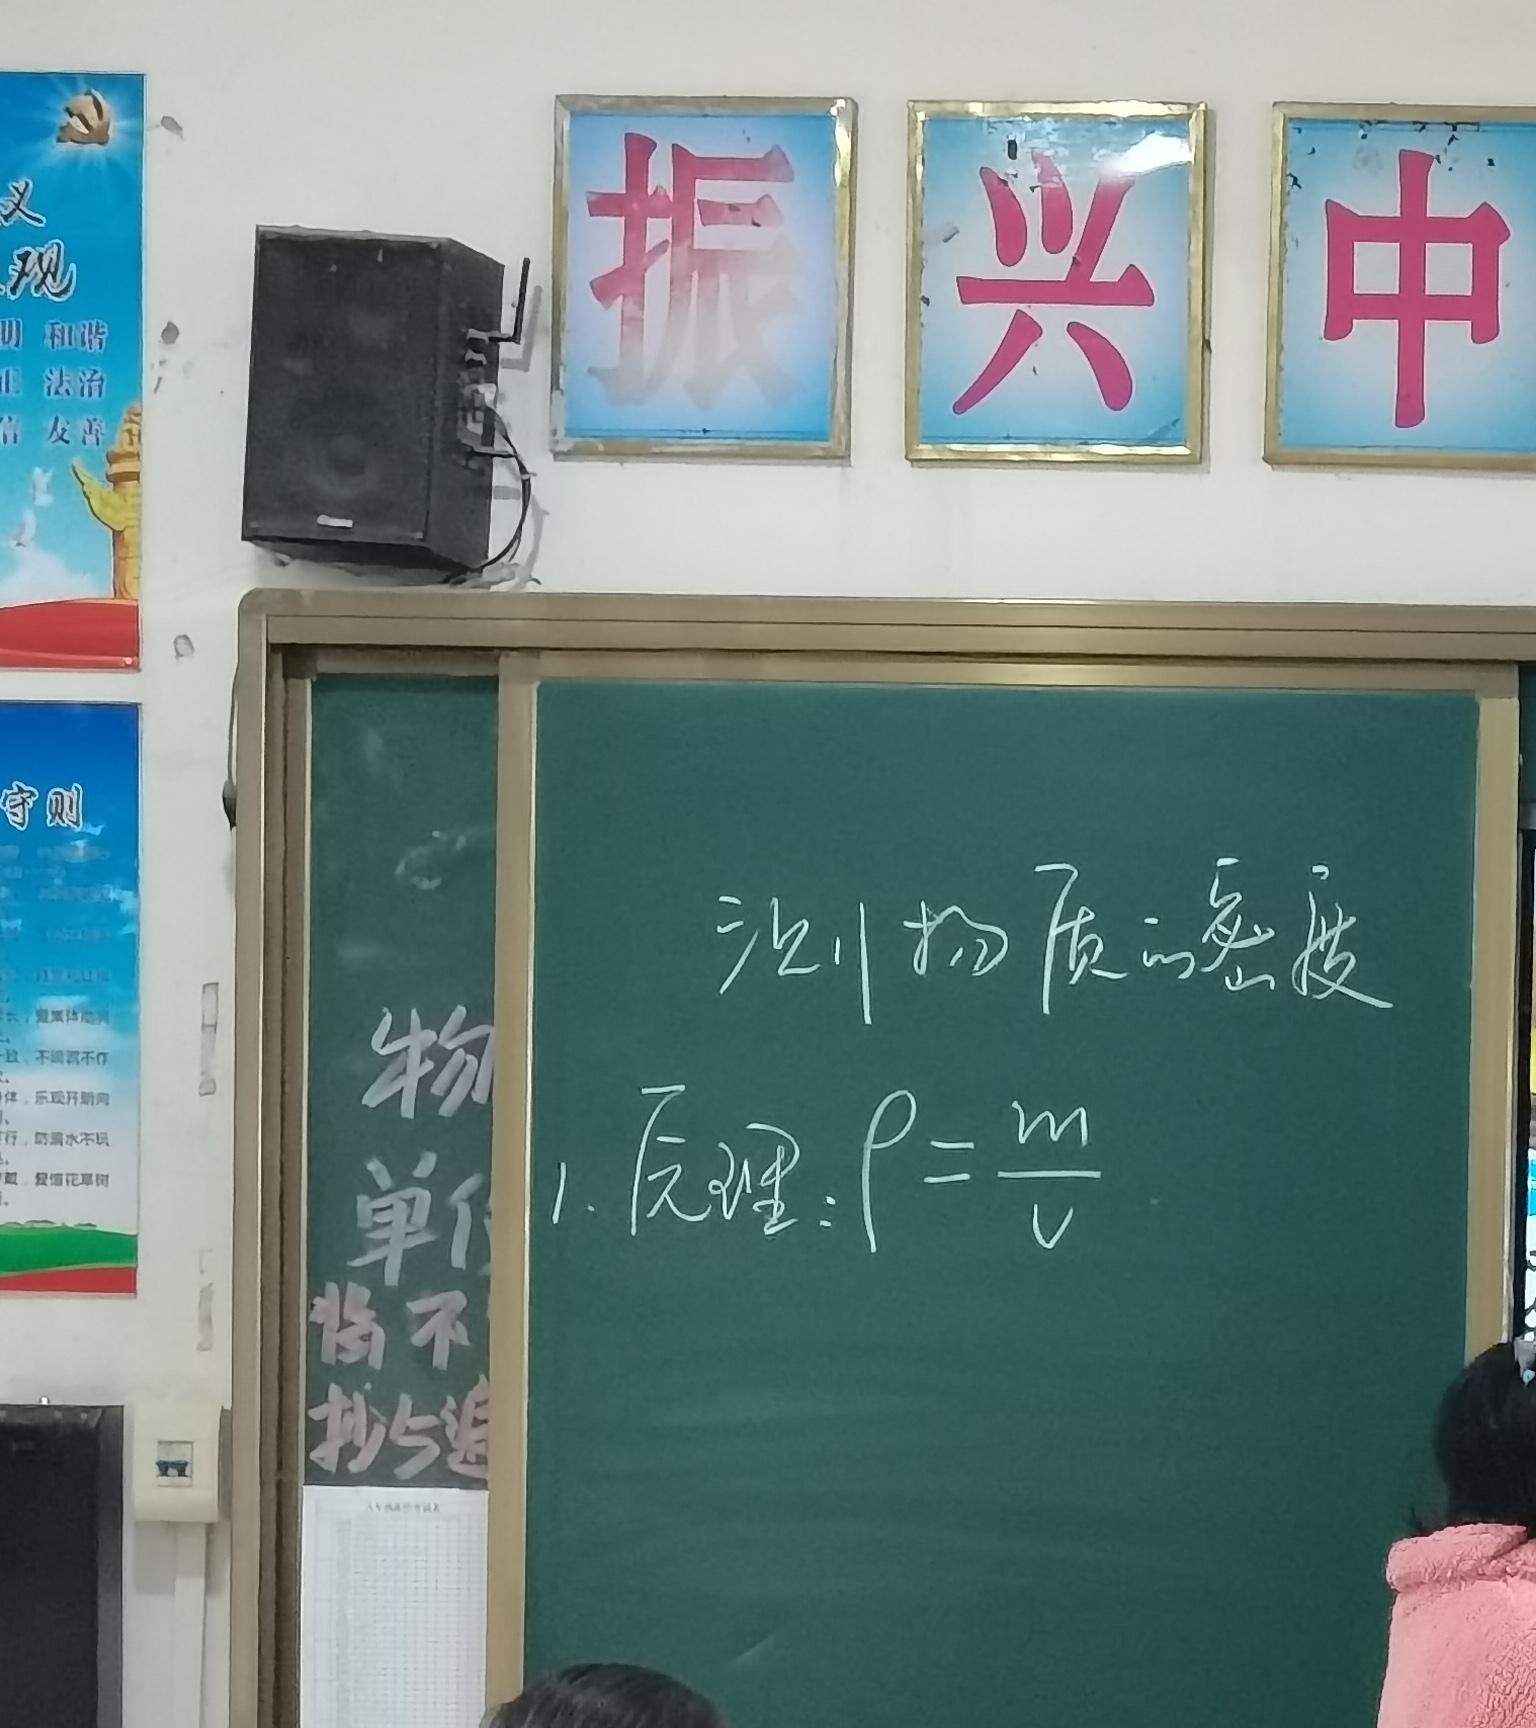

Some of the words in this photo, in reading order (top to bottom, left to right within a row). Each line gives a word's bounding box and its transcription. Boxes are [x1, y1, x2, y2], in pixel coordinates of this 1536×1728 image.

[46, 368, 105, 398] 法治
[48, 414, 104, 447] 友善
[0, 782, 83, 830] 守则
